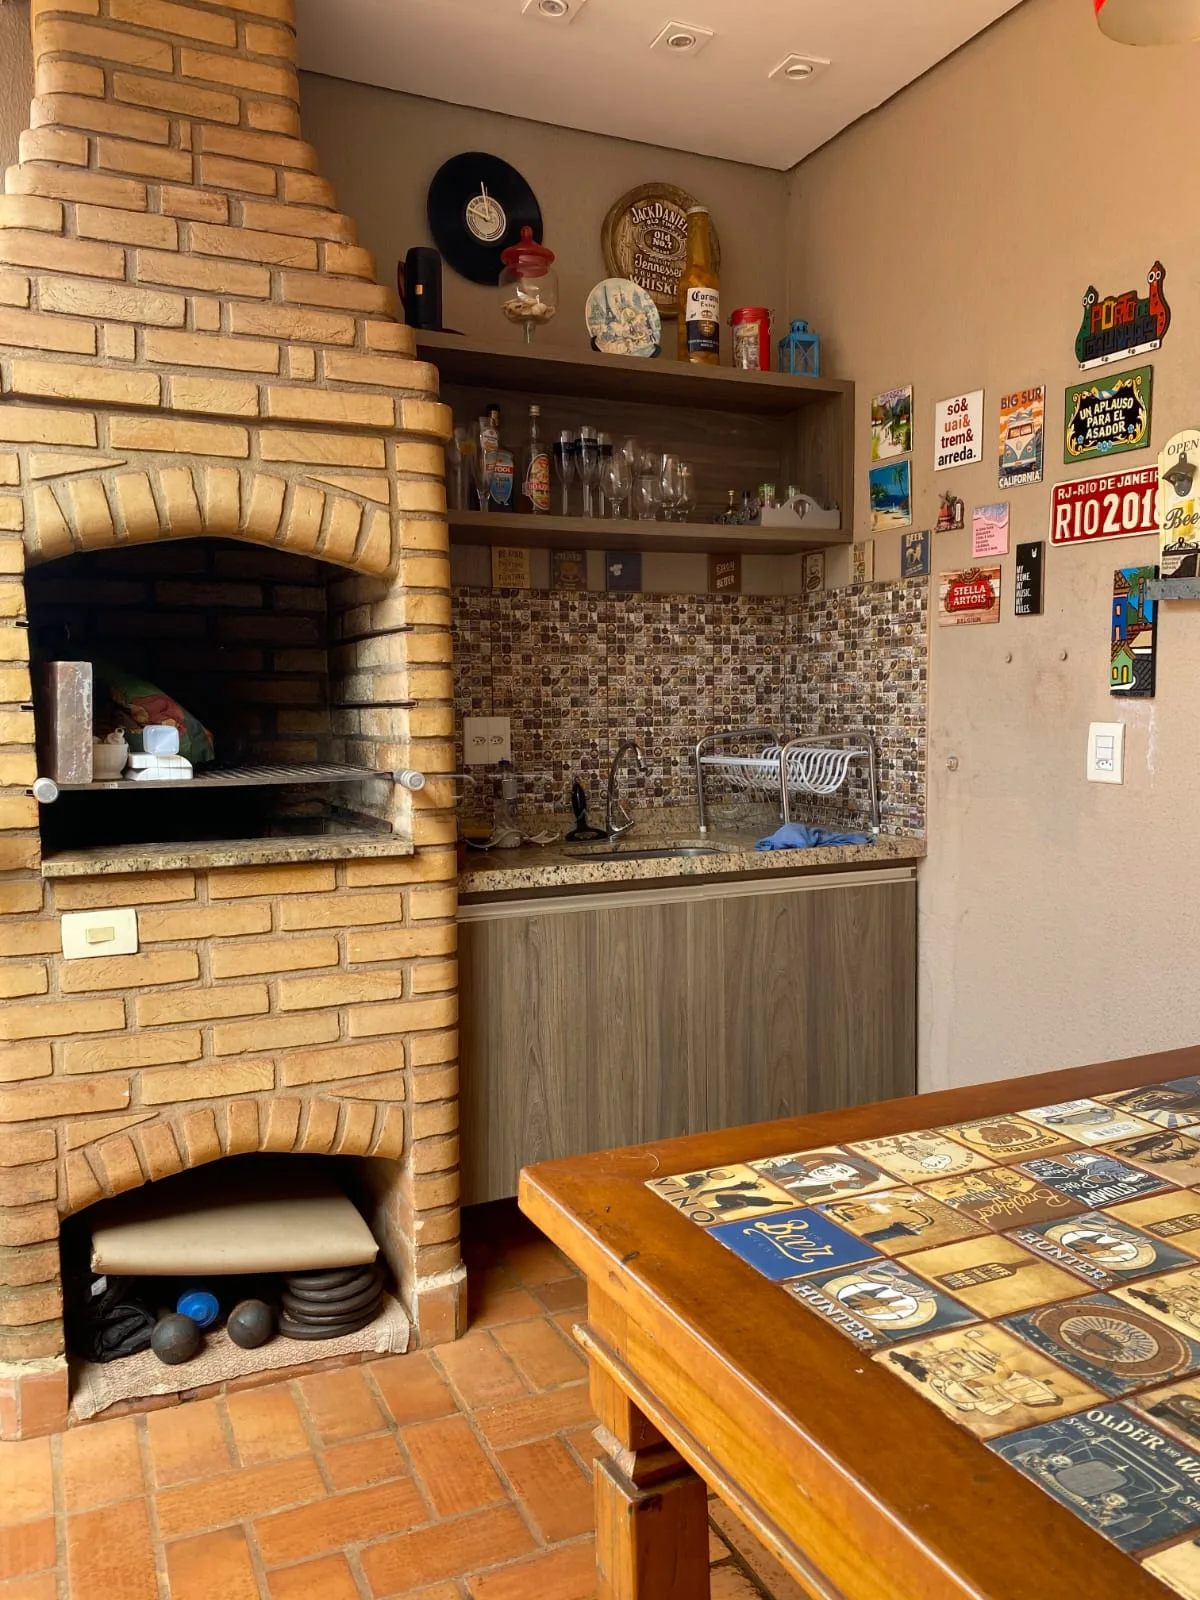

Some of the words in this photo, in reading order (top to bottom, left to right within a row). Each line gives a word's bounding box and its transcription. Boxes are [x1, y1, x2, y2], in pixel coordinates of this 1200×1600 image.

[631, 205, 655, 224] JACK
[655, 202, 688, 235] DANIEL
[654, 231, 671, 241] Old
[629, 274, 677, 296] WHISK
[1000, 395, 1019, 410] BIG
[1021, 387, 1042, 403] SUR
[1080, 404, 1092, 421] UN
[1093, 397, 1134, 415] APLAUSO
[944, 413, 971, 433] uai&
[1086, 411, 1111, 428] PARA
[1113, 409, 1126, 423] EL
[940, 428, 974, 449] trem&
[1085, 420, 1126, 440] ASADOR
[937, 446, 977, 467] arreda.
[1167, 438, 1200, 457] OPEN
[999, 471, 1041, 489] CALIFORNIA
[1057, 482, 1098, 500] RJ-RIO
[1099, 478, 1116, 491] DE
[1117, 470, 1159, 488] JANEI
[1163, 506, 1200, 530] Bee
[905, 533, 924, 547] BEER
[953, 585, 986, 596] STELLA
[953, 594, 986, 606] ARTOIS
[655, 1178, 717, 1225] VINO
[976, 1187, 1070, 1223] Breakfast
[1077, 1181, 1138, 1209] STUMPY
[748, 1219, 835, 1260] Beer
[1018, 1232, 1107, 1281] HUNTER
[793, 1283, 874, 1342] HUNTER
[1086, 1410, 1165, 1450] OLDER
